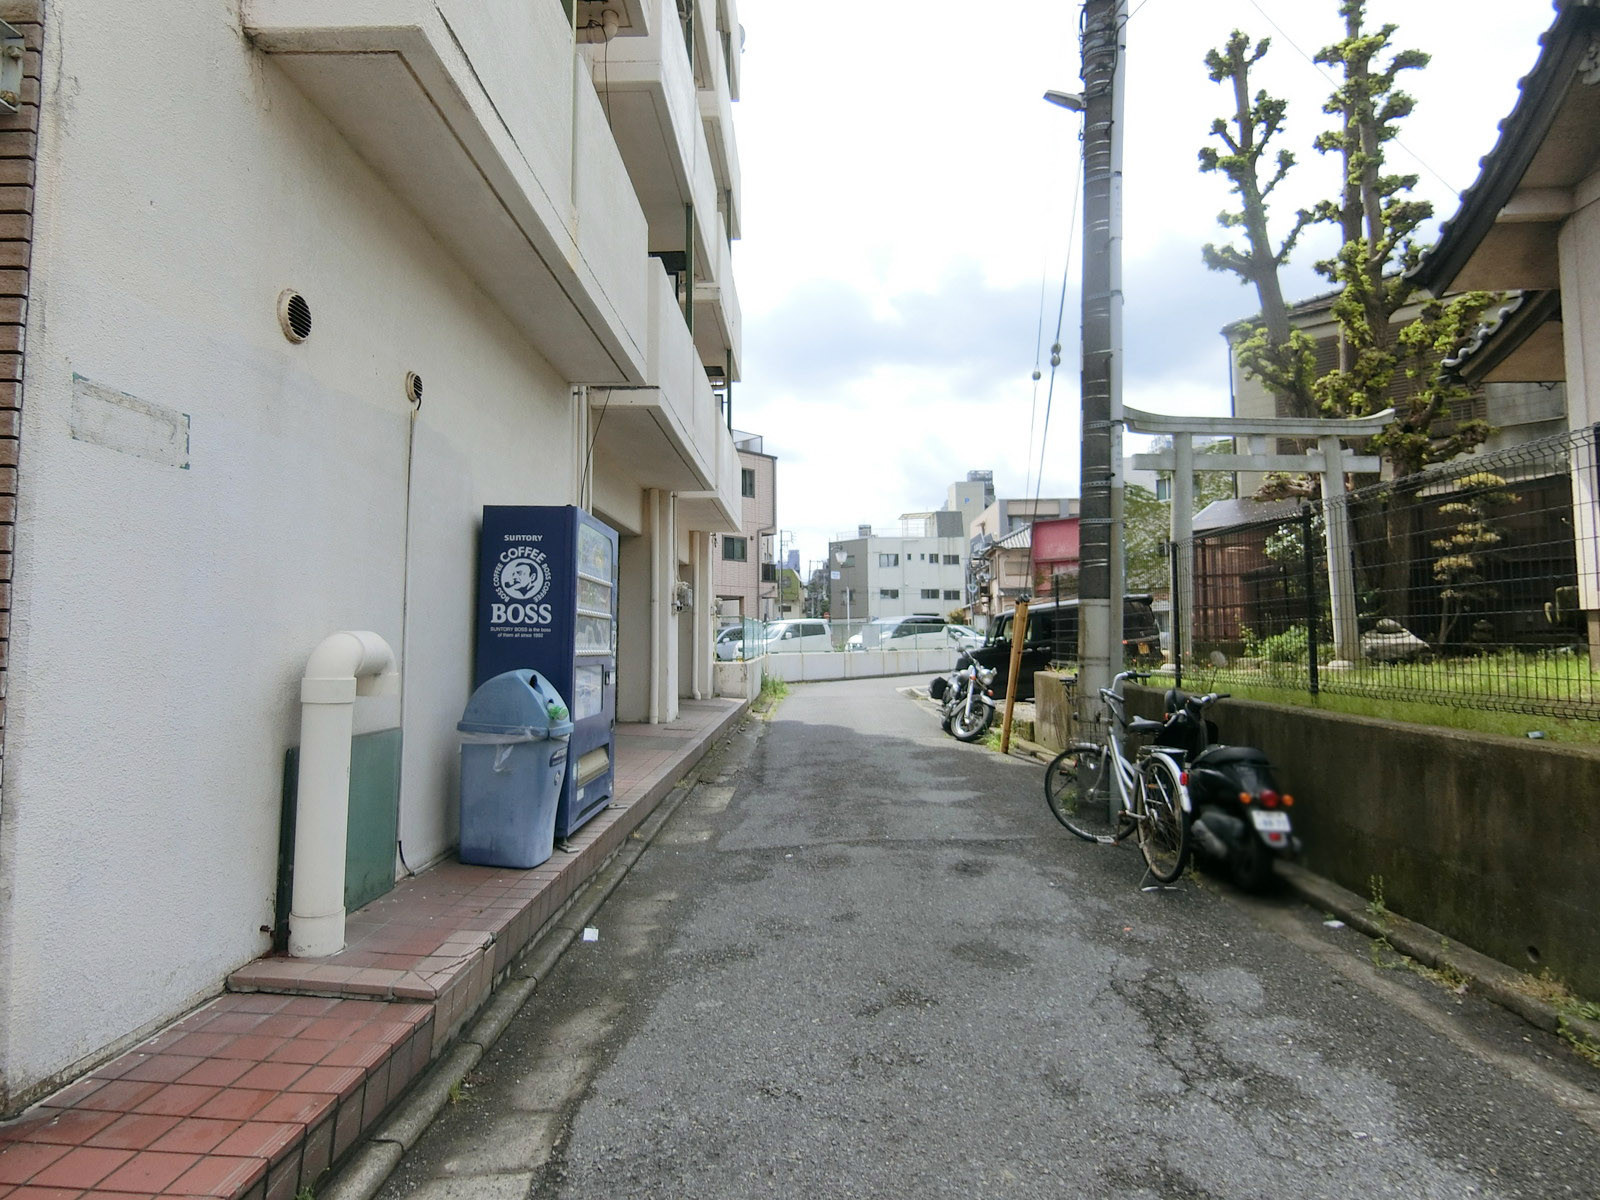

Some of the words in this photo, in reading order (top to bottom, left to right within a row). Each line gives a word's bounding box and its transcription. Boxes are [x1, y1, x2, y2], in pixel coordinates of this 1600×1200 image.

[504, 534, 543, 542] SUNTORY
[499, 546, 547, 563] COFFEE
[493, 562, 504, 587] COFFEE
[541, 563, 552, 581] BOSS
[495, 587, 510, 603] BOSS
[533, 581, 551, 603] COFFEE
[490, 603, 552, 624] BOSS
